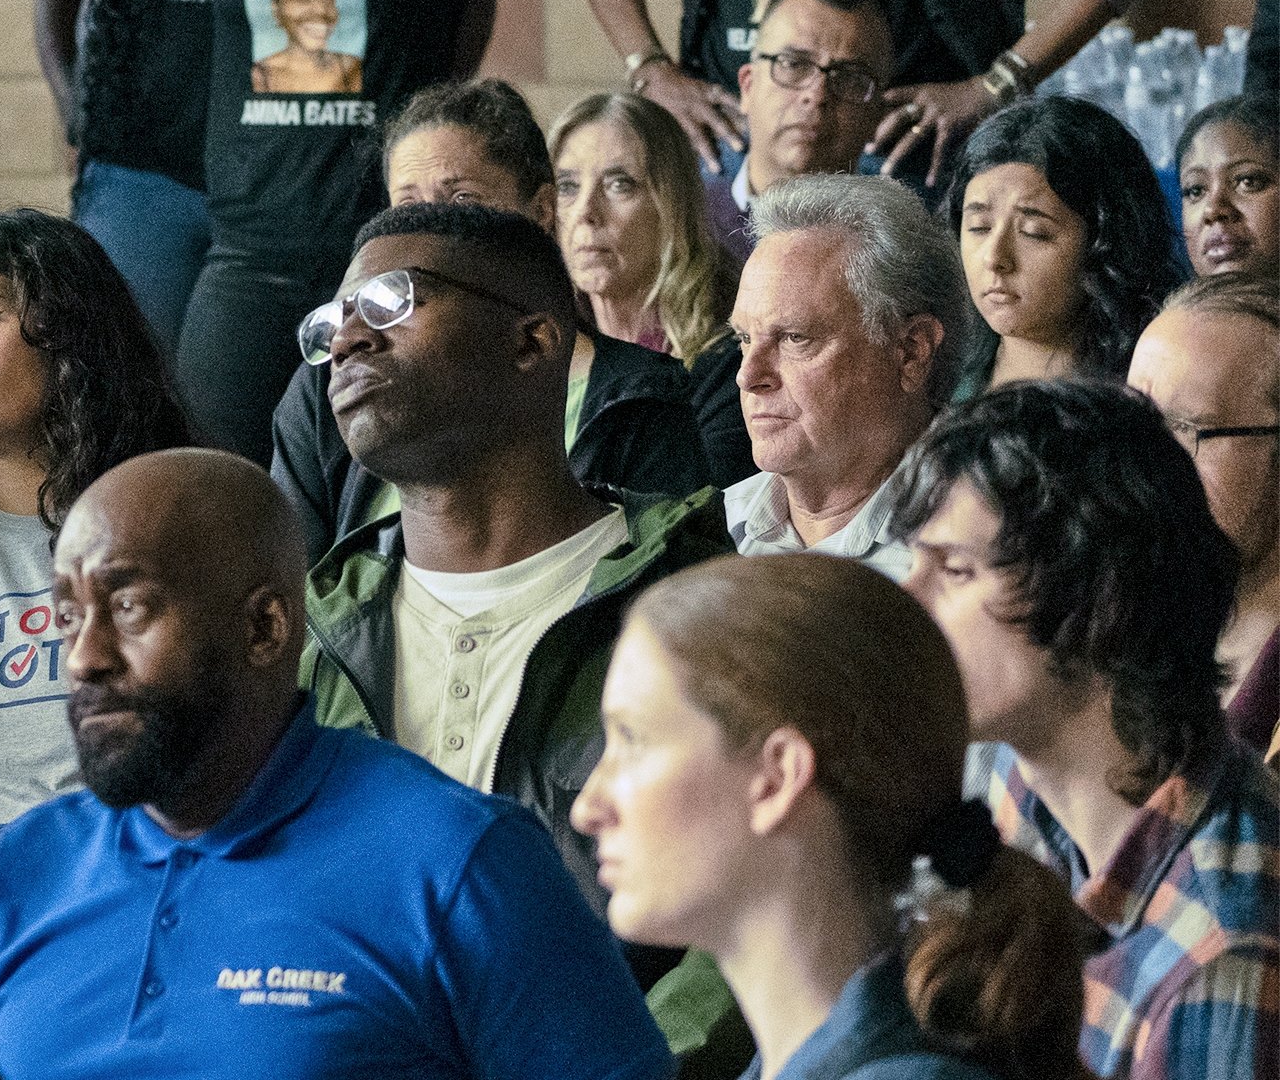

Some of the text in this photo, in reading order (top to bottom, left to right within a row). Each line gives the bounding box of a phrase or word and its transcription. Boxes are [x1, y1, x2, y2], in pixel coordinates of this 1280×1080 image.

[303, 100, 378, 127] BATES
[217, 966, 347, 995] OAK CREEK
